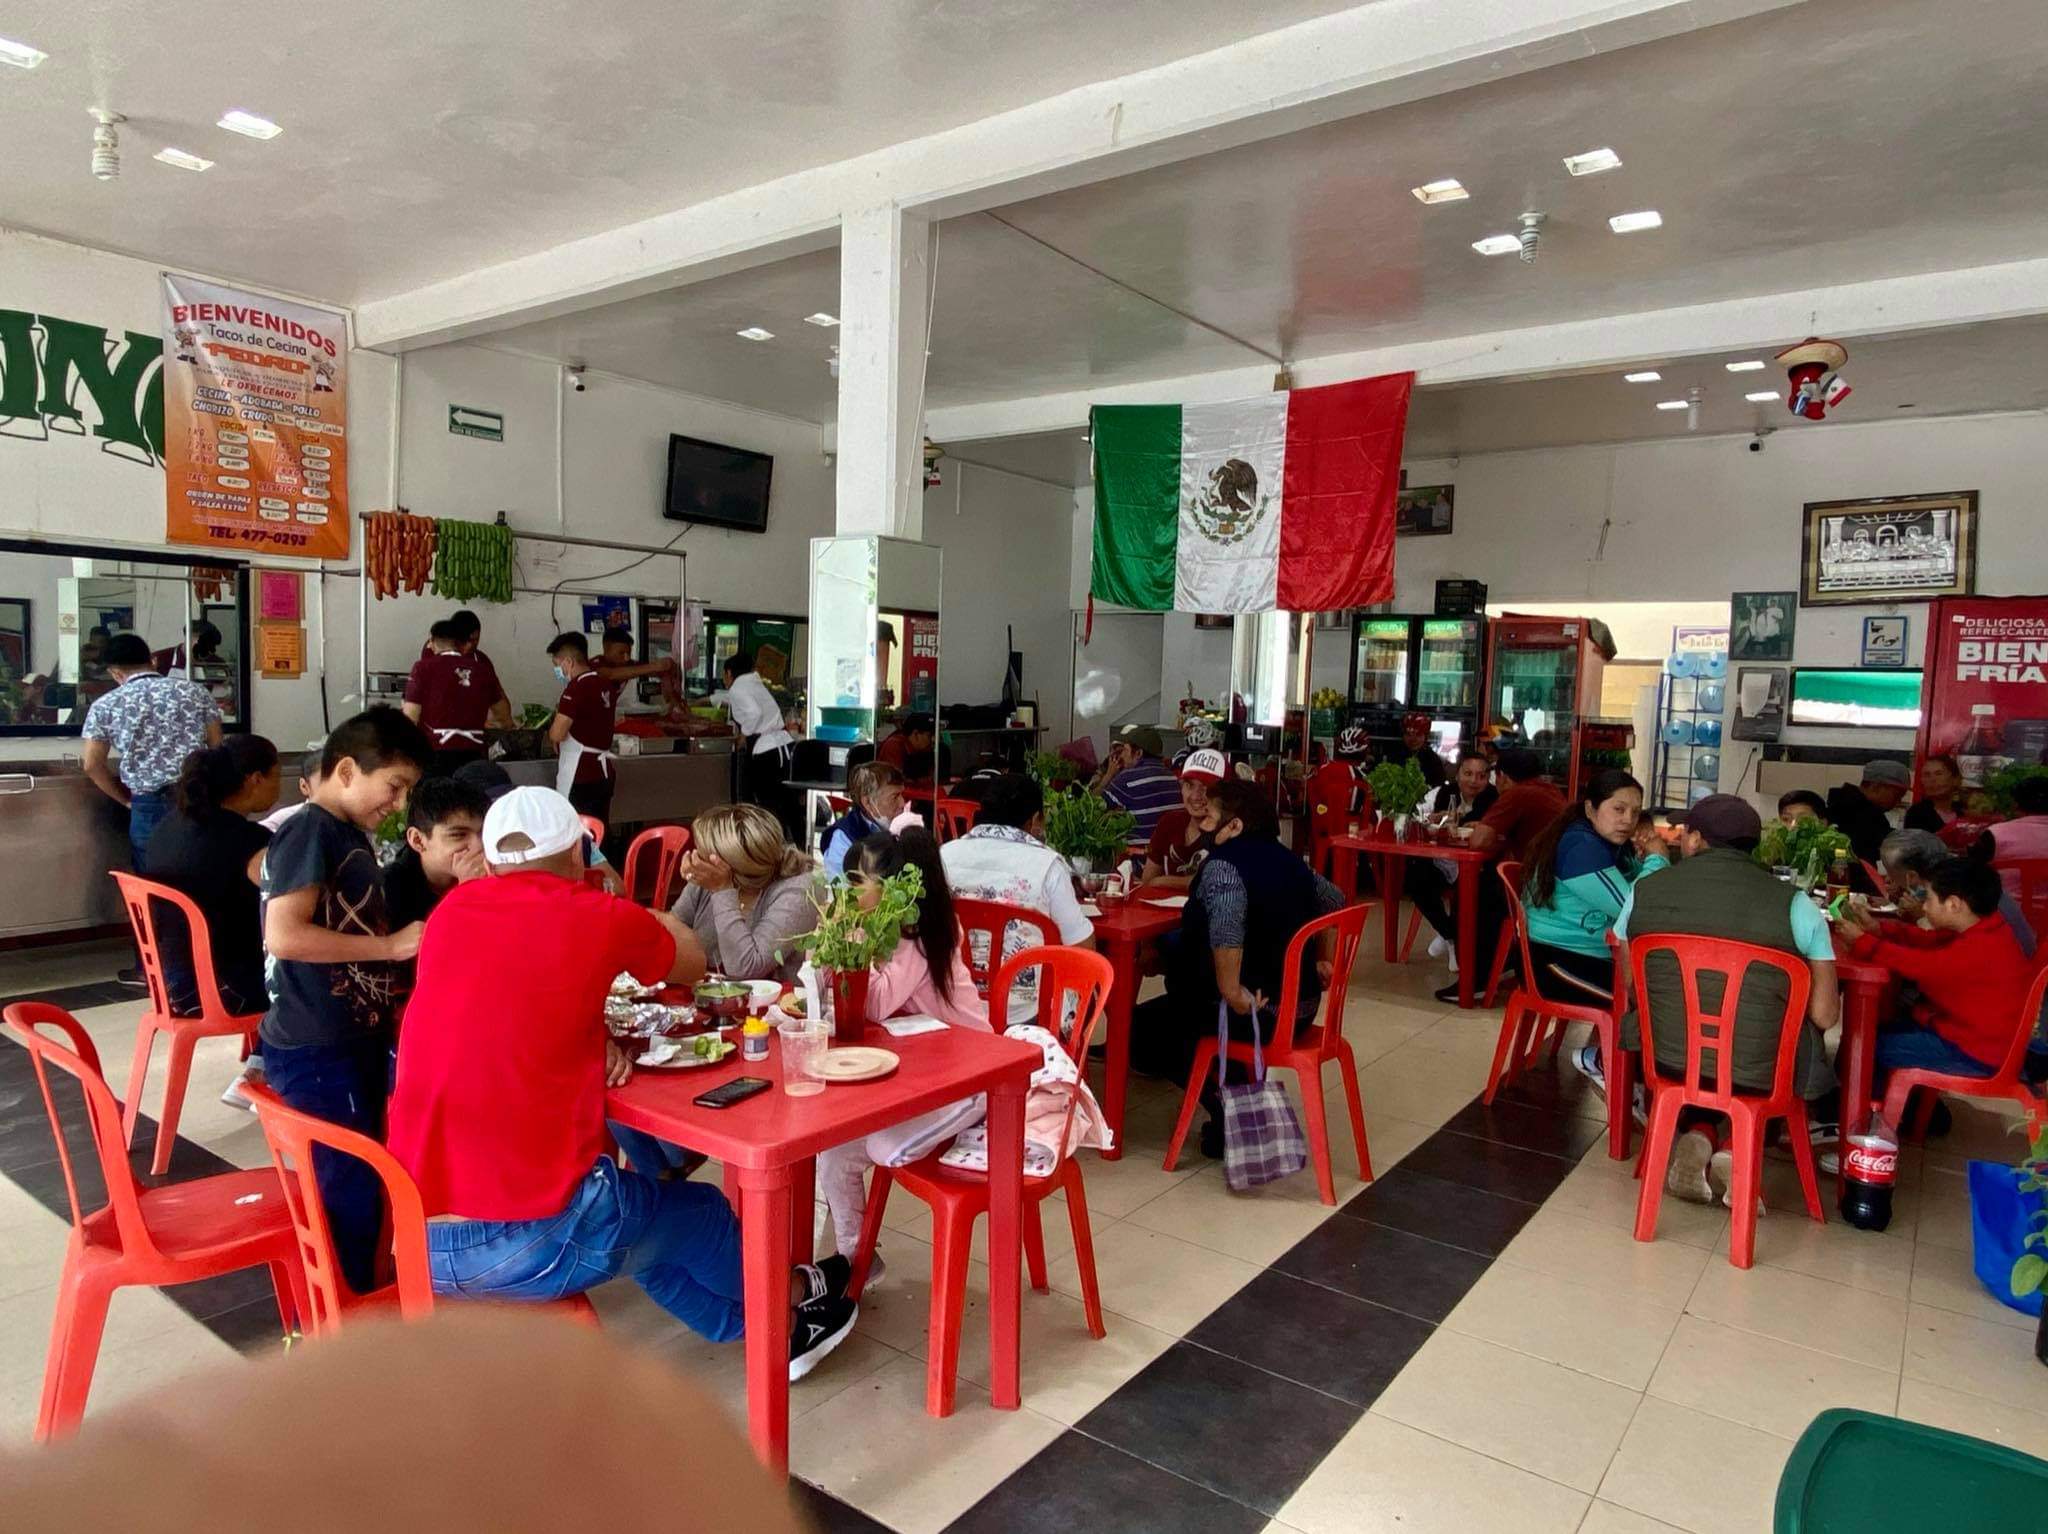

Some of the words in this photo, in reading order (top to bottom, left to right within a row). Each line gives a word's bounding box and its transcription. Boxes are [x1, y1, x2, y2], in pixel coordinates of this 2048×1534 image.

[172, 303, 337, 358] BIENVENIDOS
[208, 323, 244, 342] Tacos
[247, 334, 263, 347] de
[266, 336, 307, 357] Cecina
[237, 380, 298, 400] OFRECEMOS
[192, 400, 234, 416] CHORIZO
[240, 408, 274, 423] CRUDO
[196, 386, 232, 401] CECINA
[291, 403, 321, 418] POLLO
[240, 528, 307, 547] 477-0293
[1959, 627, 2048, 636] REFRESCANTE
[1965, 618, 2045, 628] DELICIOSA
[1958, 641, 2048, 663] BIEN
[1957, 663, 2047, 683] FRÍA
[1848, 1149, 1898, 1172] Coca-Cola
